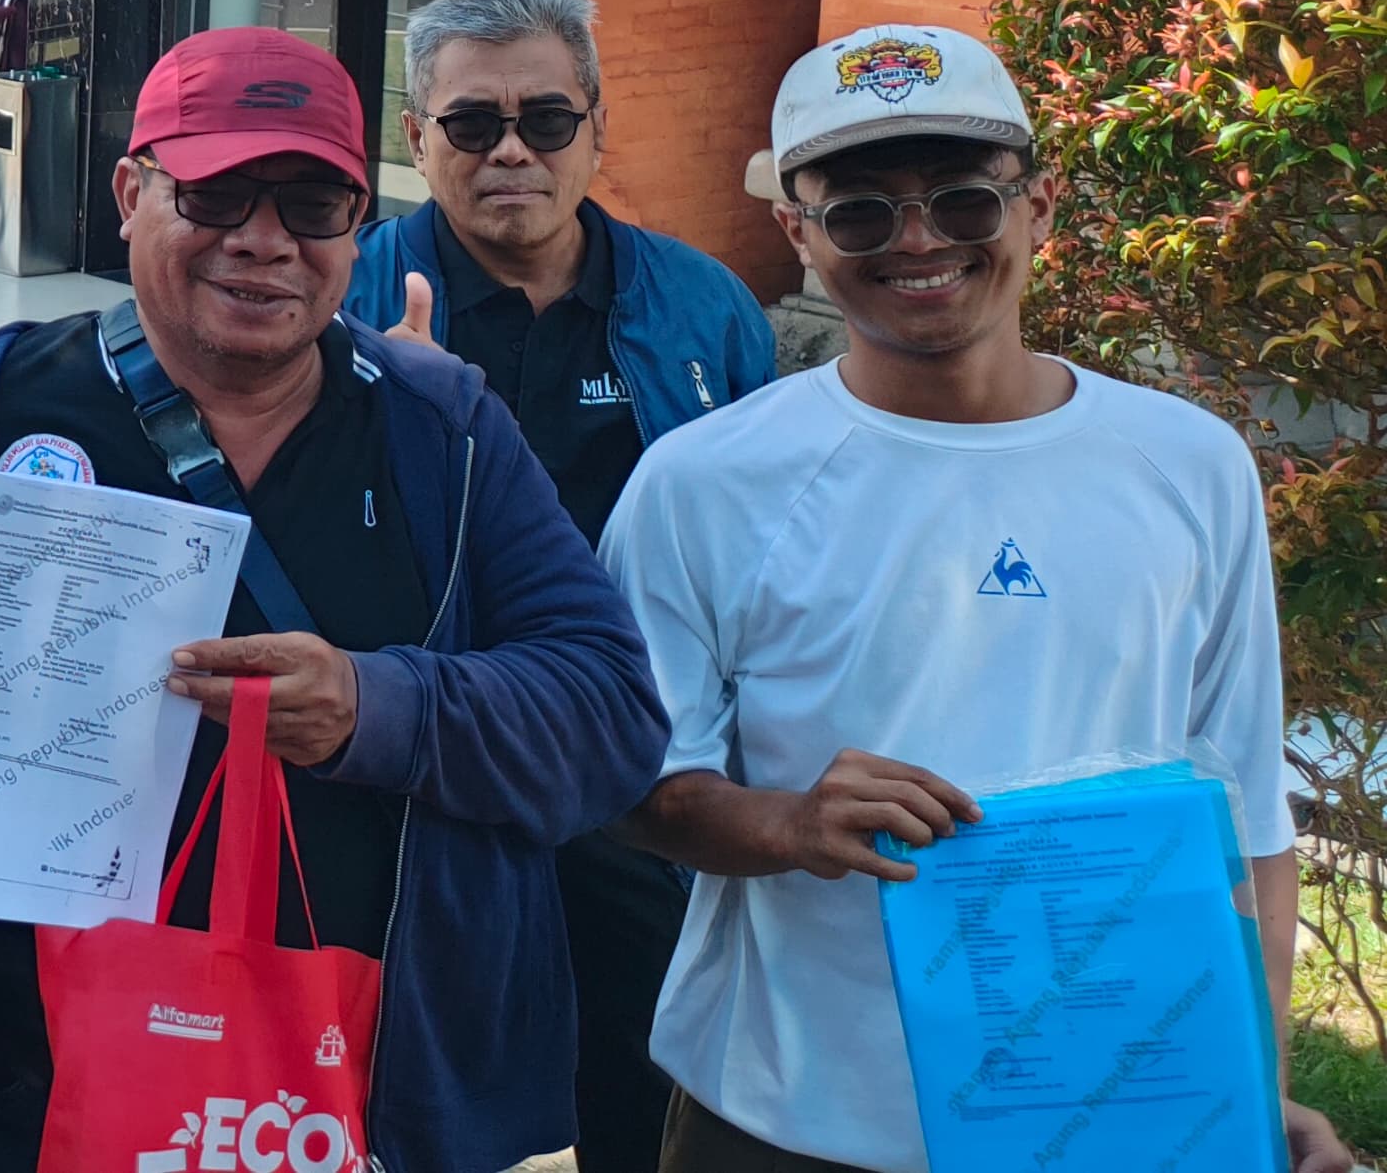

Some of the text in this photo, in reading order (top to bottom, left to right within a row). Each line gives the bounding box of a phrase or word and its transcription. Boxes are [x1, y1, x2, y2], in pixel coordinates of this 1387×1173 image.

[41, 602, 119, 659] Republik
[47, 787, 136, 852] lik Indone
[148, 1002, 225, 1030] Alfamart
[198, 1096, 346, 1173] ECO
